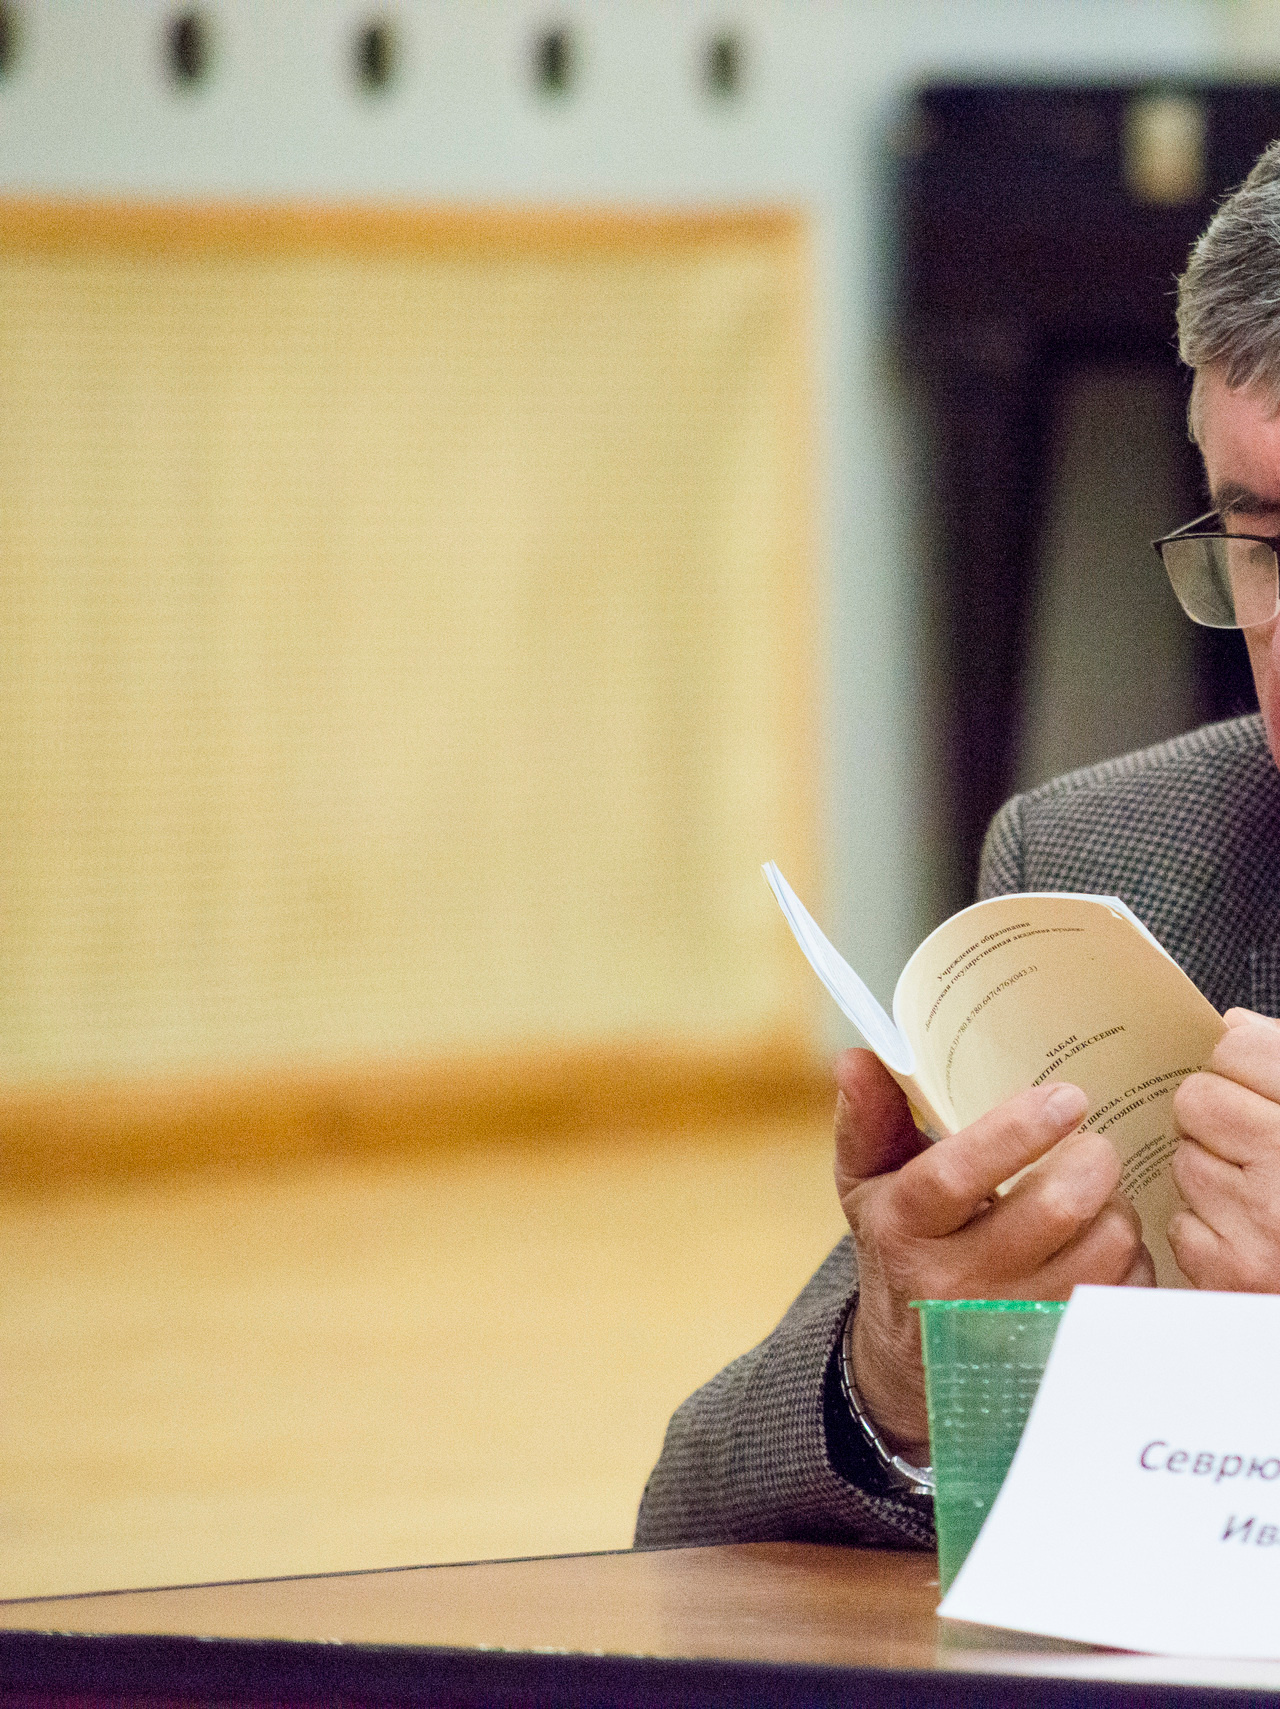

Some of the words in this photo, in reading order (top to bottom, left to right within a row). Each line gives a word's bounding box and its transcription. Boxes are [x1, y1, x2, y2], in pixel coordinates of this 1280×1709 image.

[937, 942, 980, 981] Учреждение
[1045, 1034, 1079, 1059] ЧАБАН
[1064, 1025, 1126, 1061] АЛЕКСЕЕВИЧ
